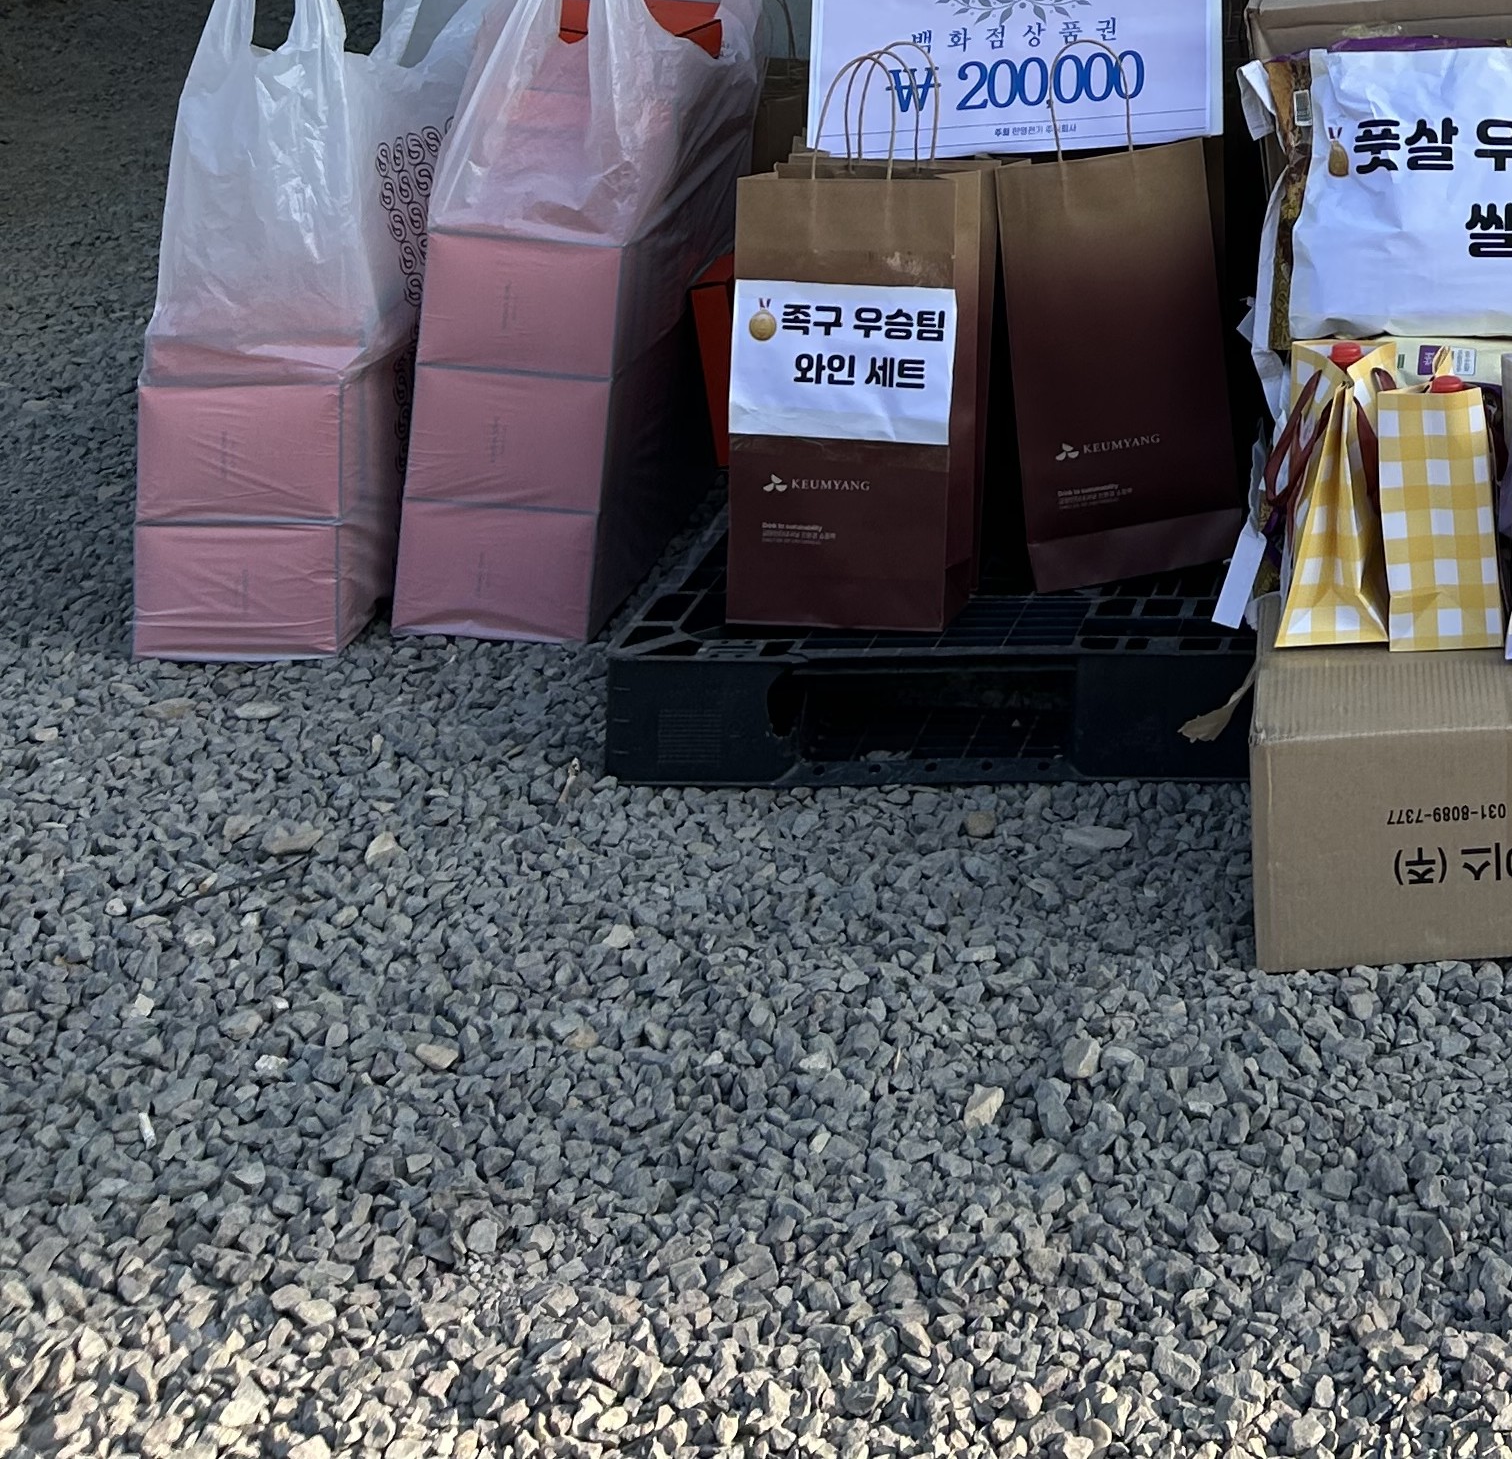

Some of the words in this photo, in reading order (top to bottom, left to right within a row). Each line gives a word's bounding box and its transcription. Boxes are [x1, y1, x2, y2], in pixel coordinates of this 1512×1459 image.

[955, 49, 1146, 111] 200,000
[1353, 117, 1460, 175] 풋살
[782, 304, 843, 336] 족구
[853, 307, 946, 342] 우승팀
[793, 353, 856, 387] 와인
[865, 356, 926, 390] 세트
[1083, 433, 1161, 454] KEUMYANG
[791, 478, 871, 491] KEUMYANG
[1386, 803, 1507, 826] 031-8089-7377
[1393, 847, 1448, 887] (주)
